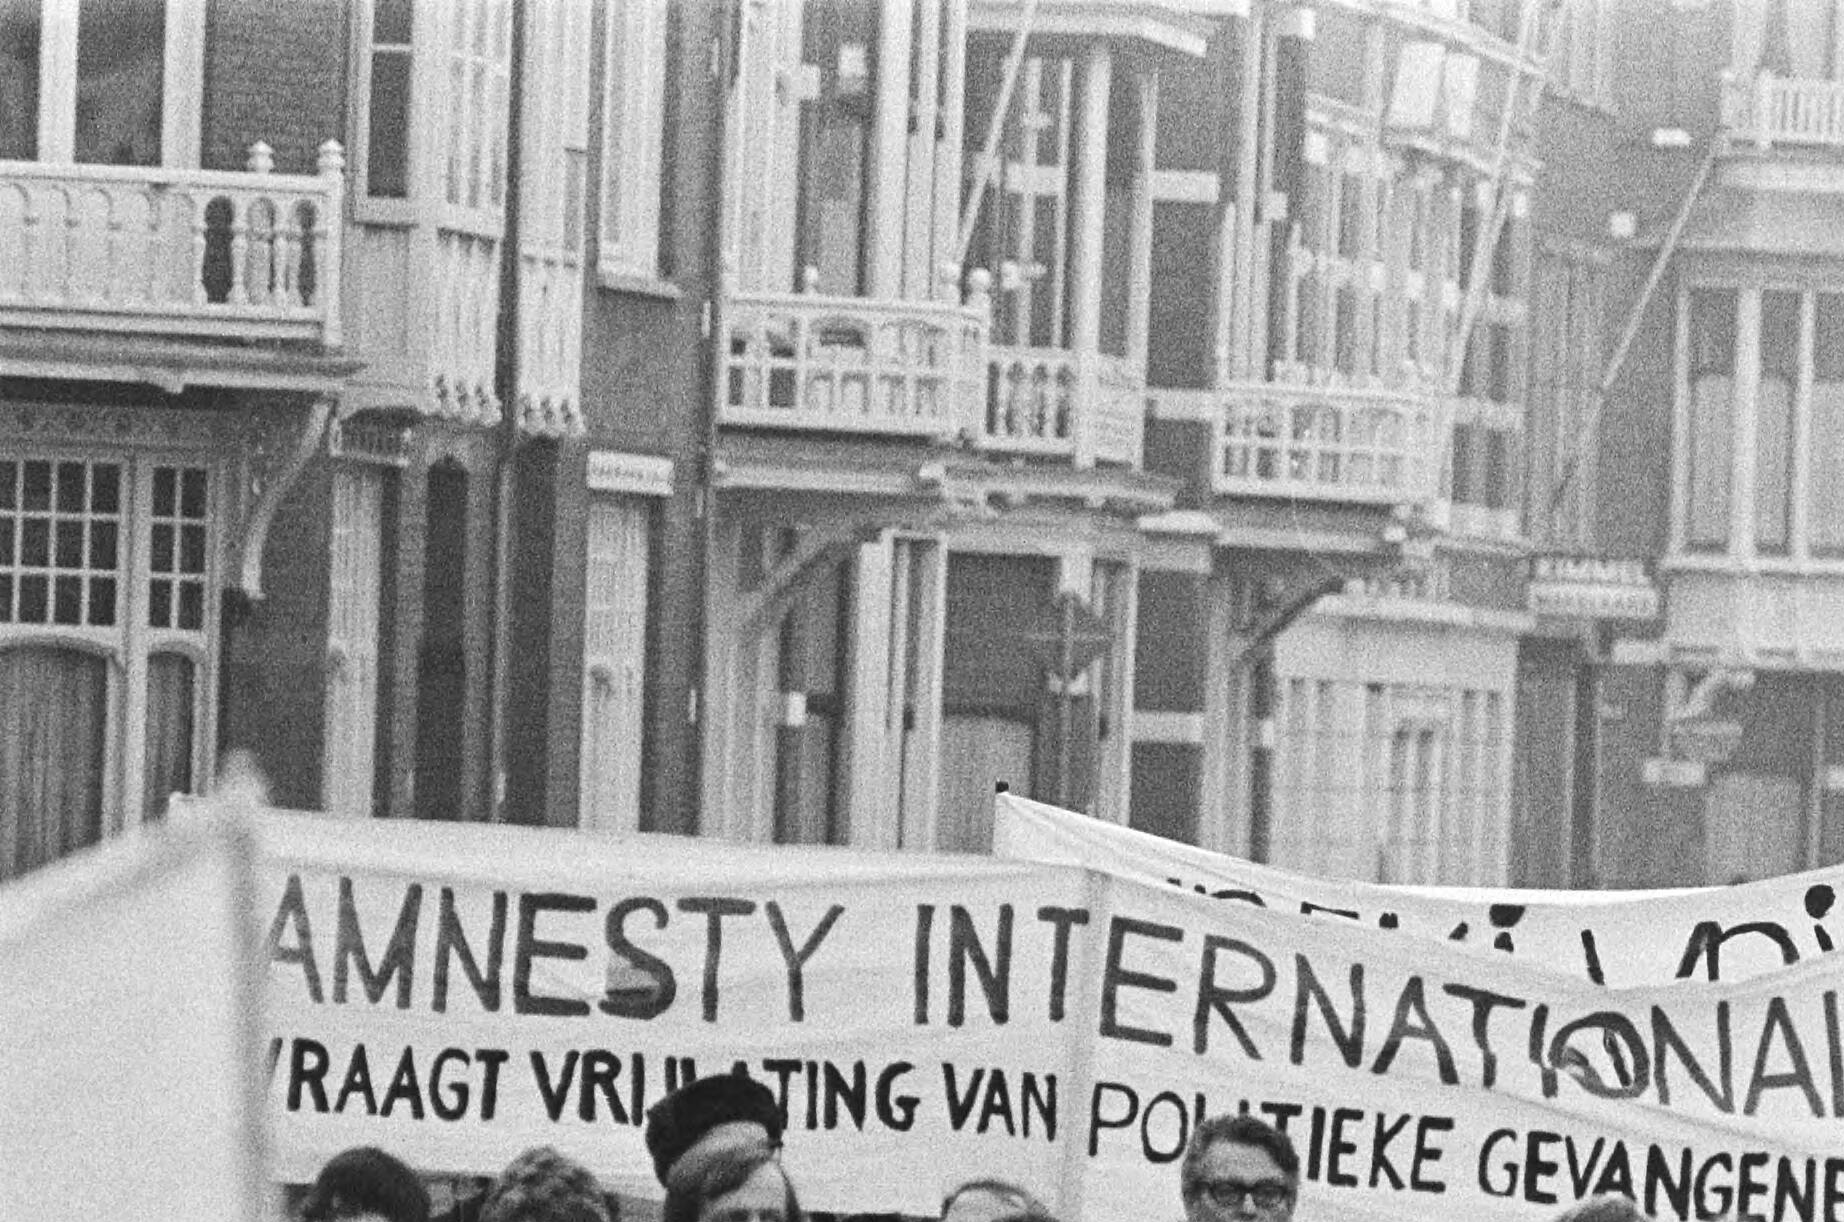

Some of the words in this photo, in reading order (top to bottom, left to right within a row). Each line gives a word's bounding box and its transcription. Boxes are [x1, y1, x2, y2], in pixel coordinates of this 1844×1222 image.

[266, 874, 845, 1022] AMNESTY
[266, 1037, 509, 1122] RAAGT
[942, 1061, 1057, 1141] VAN
